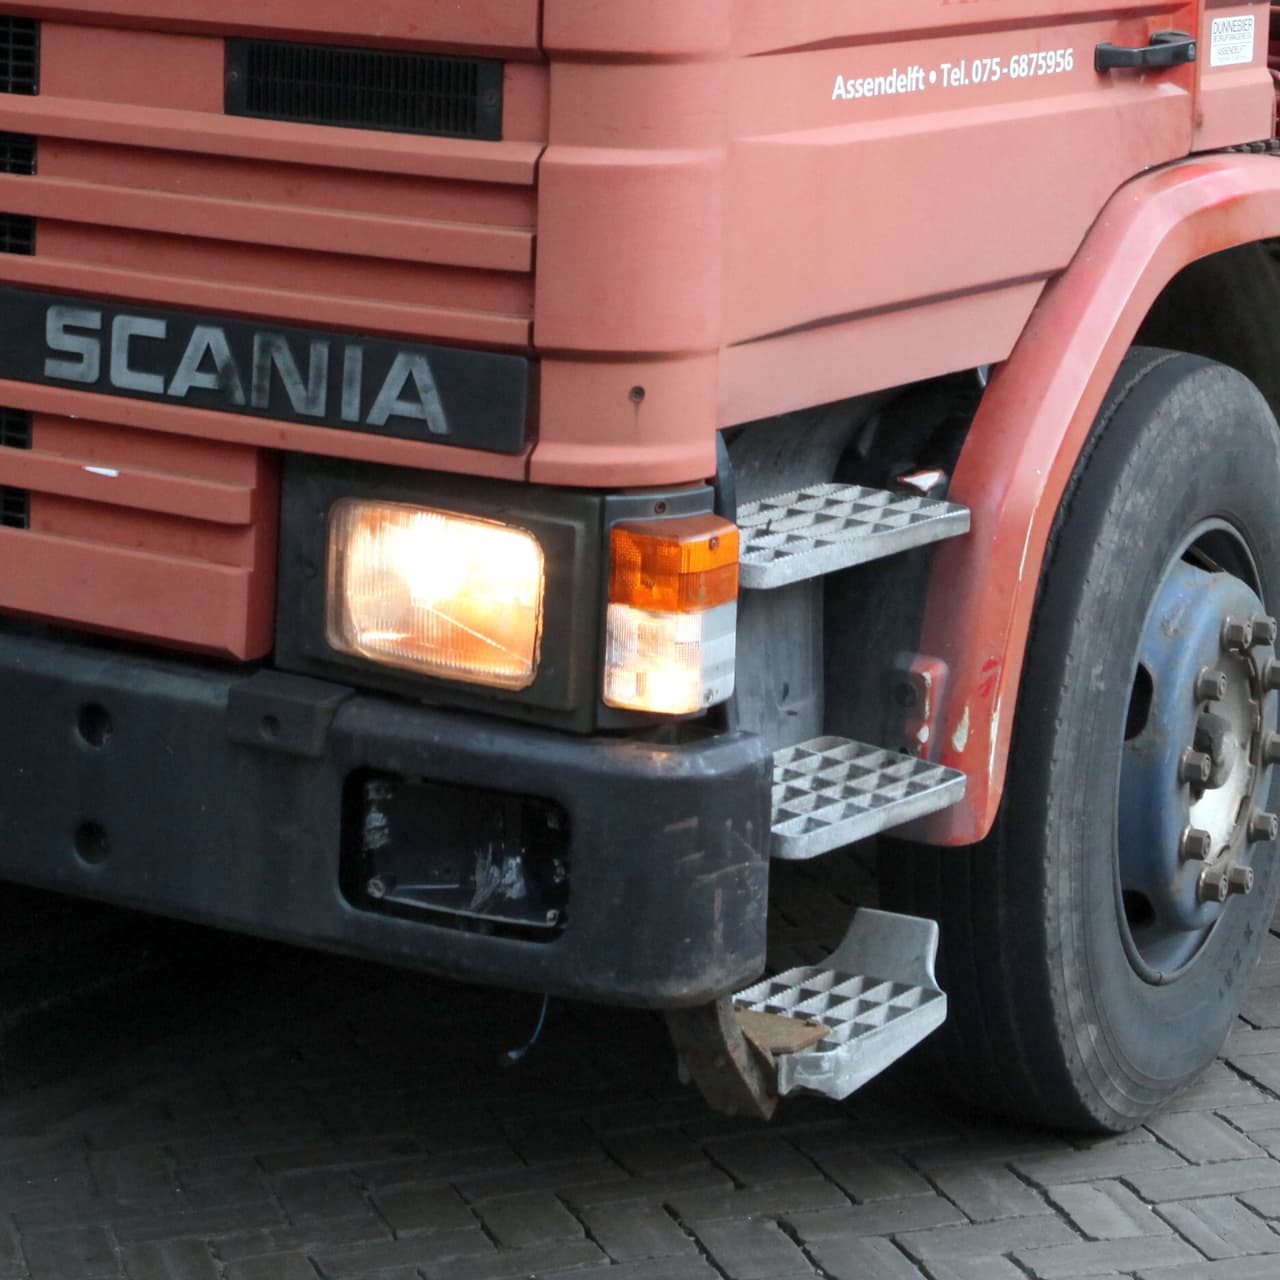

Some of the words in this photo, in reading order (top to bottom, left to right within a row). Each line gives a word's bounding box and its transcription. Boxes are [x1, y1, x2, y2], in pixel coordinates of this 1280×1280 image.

[832, 65, 925, 101] Assendelft
[940, 60, 969, 88] Tel.
[971, 47, 1074, 84] 075-6875956
[44, 306, 449, 435] SCANIA
